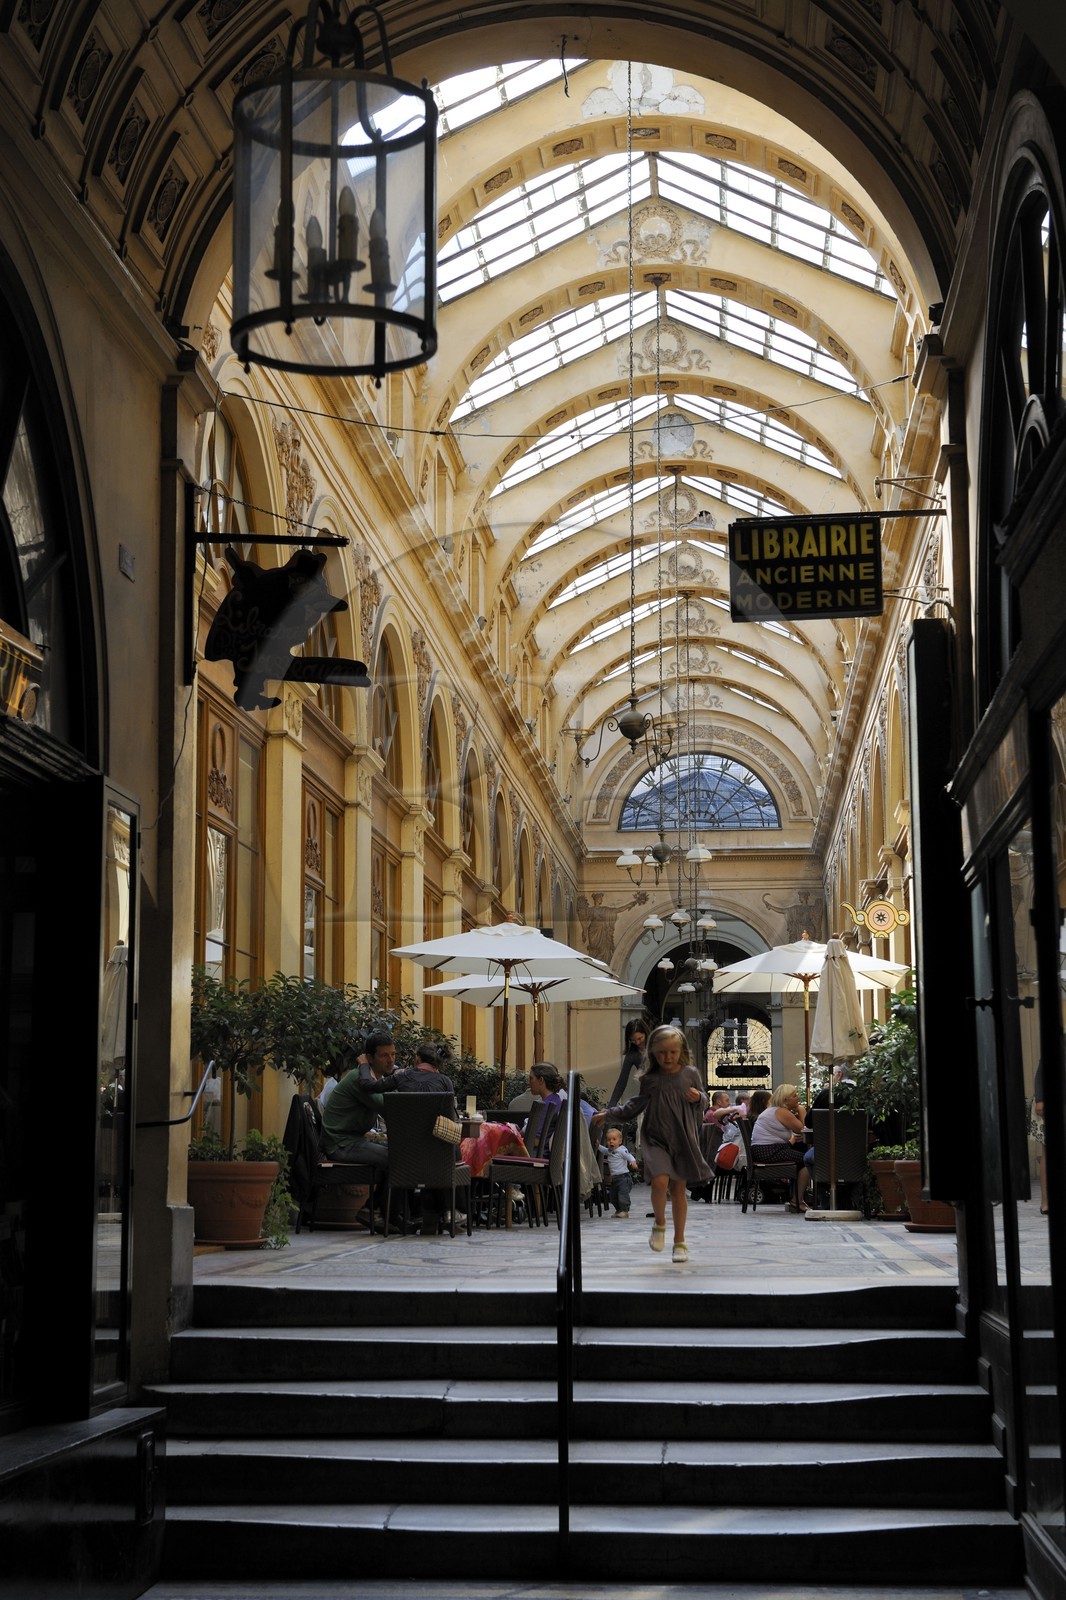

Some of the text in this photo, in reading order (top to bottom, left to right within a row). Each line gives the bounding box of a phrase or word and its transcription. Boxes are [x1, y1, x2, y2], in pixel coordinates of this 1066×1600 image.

[735, 523, 874, 561] LIBRAIRIE
[736, 562, 875, 585] ANCIENNE
[736, 587, 876, 611] MODERNE
